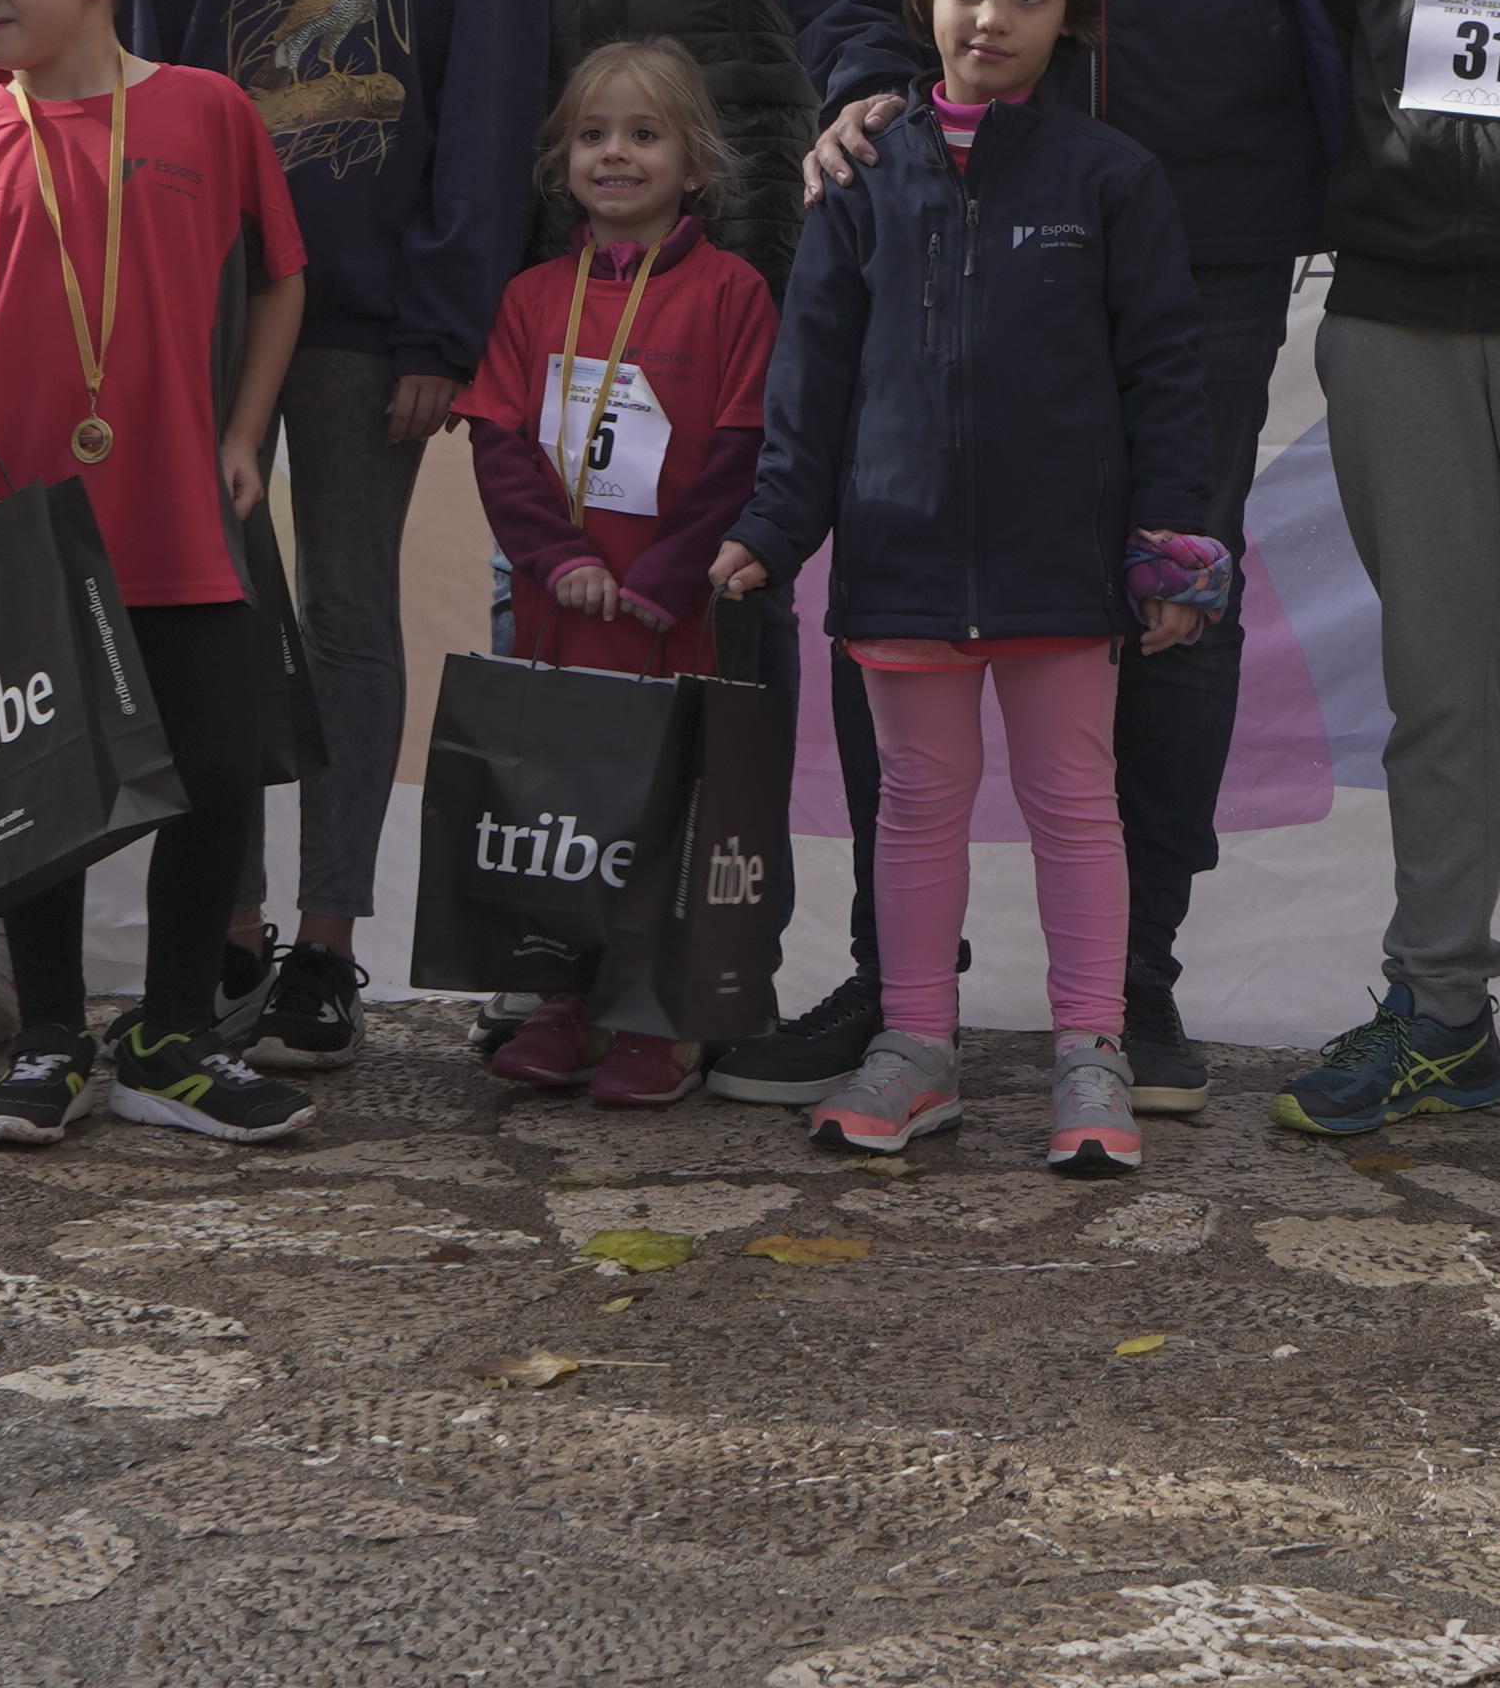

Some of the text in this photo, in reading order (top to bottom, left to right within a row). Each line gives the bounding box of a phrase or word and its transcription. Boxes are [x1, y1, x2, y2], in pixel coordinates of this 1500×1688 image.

[1041, 224, 1086, 237] Esports
[587, 412, 618, 470] 5
[476, 811, 637, 889] tribe
